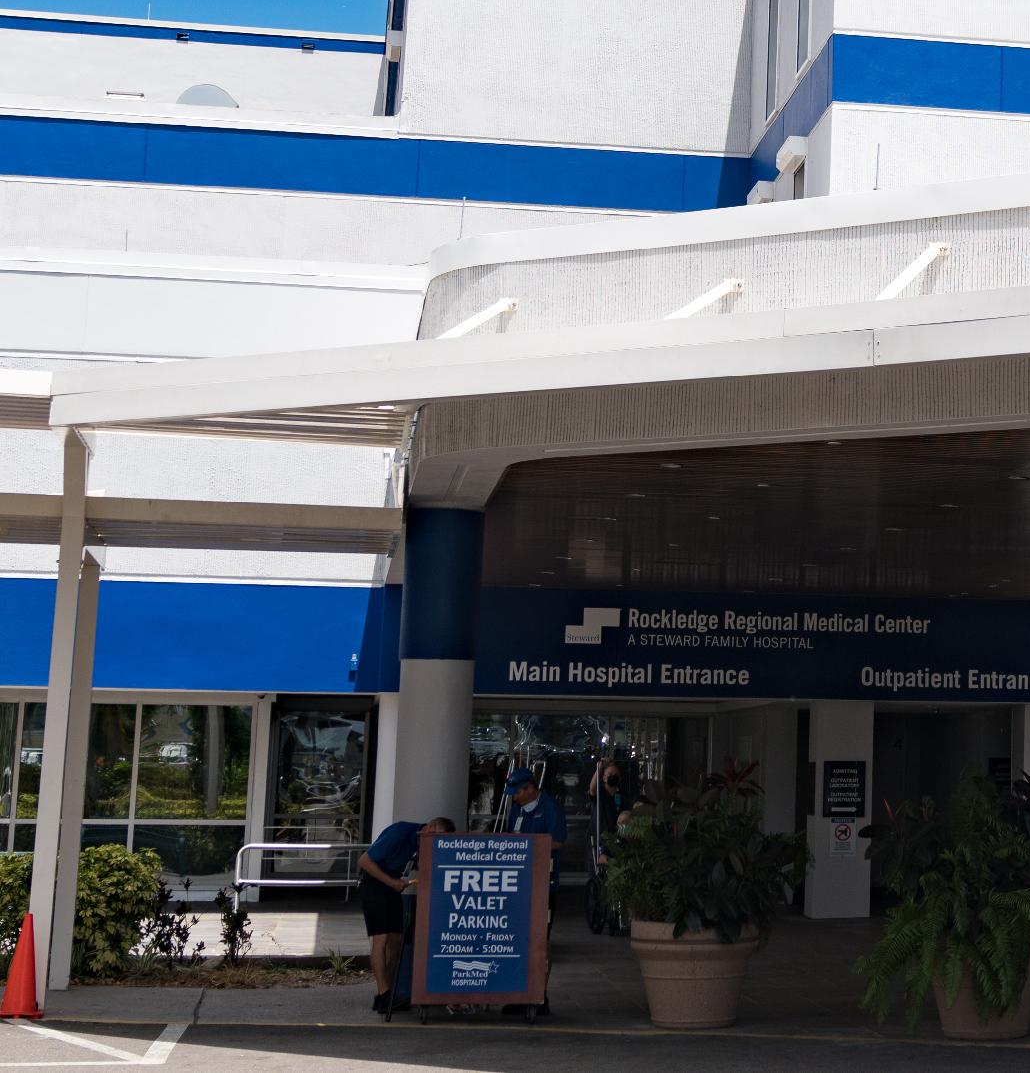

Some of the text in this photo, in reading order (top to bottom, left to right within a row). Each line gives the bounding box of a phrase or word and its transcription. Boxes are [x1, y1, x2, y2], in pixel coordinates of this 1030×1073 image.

[628, 608, 931, 634] Rockledge Regional Medical Center
[566, 633, 600, 642] Steward
[627, 634, 814, 649] A STEWARD FAMILY HOSPITAL
[508, 661, 750, 688] Main Hospital Entrance
[861, 666, 961, 692] Outpatient
[893, 738, 902, 750] 4
[437, 839, 528, 851] Rockledge Regional
[455, 852, 527, 861] Medical Center
[443, 870, 518, 892] FREE
[451, 894, 507, 910] VALET
[448, 912, 509, 929] PARKING
[441, 932, 478, 941] MONDAY
[485, 932, 515, 941] FRIDAY
[440, 944, 473, 953] 7:00AM
[482, 944, 514, 953] 5:00PM
[452, 970, 488, 978] ParkMed
